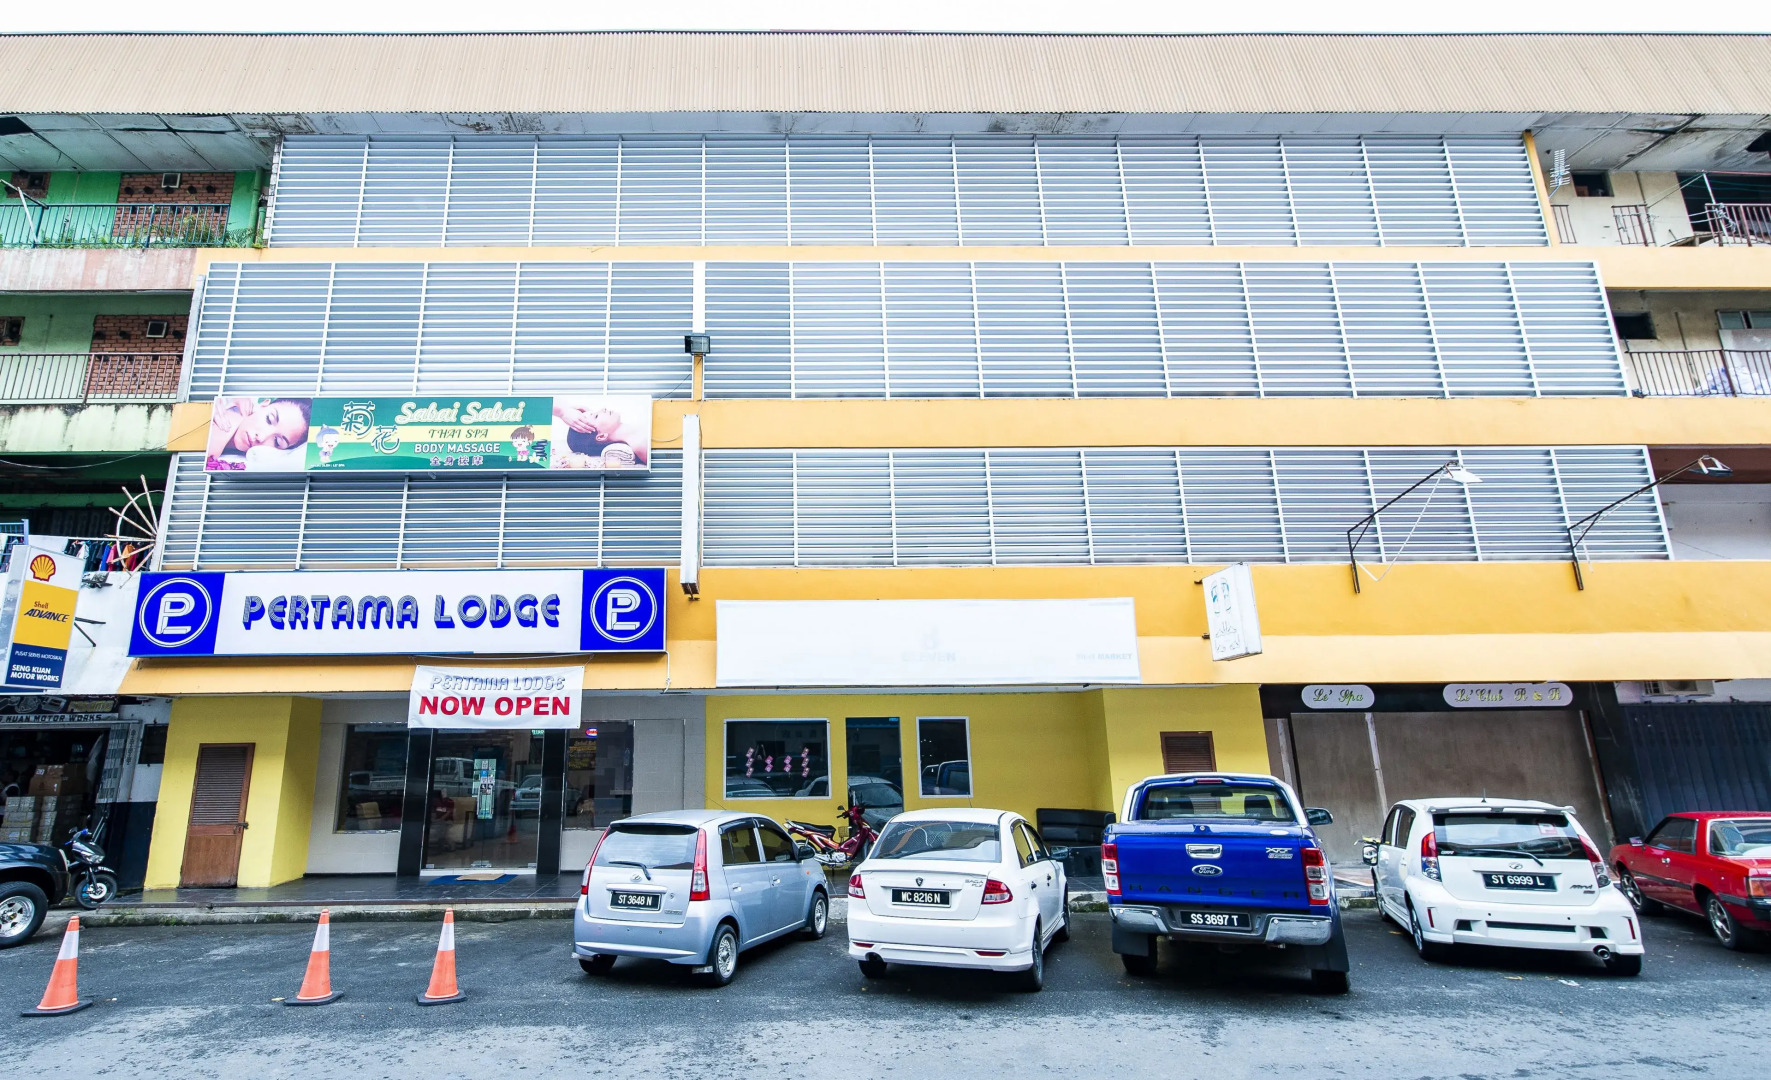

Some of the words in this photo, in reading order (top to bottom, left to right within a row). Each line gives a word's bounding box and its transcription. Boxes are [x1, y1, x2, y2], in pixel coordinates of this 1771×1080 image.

[395, 402, 460, 424] Sabai
[461, 402, 526, 424] Sabai
[428, 428, 462, 439] THAI
[465, 428, 489, 439] SPA
[414, 443, 445, 454] BODY
[447, 443, 500, 454] MASSAGE
[430, 455, 484, 467] 全身按摩
[34, 601, 49, 609] Shell
[24, 608, 70, 623] ADVANCE
[242, 594, 419, 631] PERTAMA
[434, 593, 561, 629] LODGE
[12, 664, 31, 673] SENG
[32, 666, 51, 675] KUAN
[10, 672, 36, 681] MOTOR
[36, 674, 60, 682] WORKS
[430, 675, 509, 691] PERTAMA
[513, 675, 566, 691] LODGE
[1338, 688, 1364, 706] Spa
[1475, 688, 1504, 702] Club
[1514, 688, 1528, 701] R
[1533, 690, 1543, 701] &
[1547, 687, 1562, 701] R
[419, 696, 486, 716] NOW
[494, 696, 570, 716] OPEN
[6, 715, 31, 723] KUAN
[34, 714, 65, 723] MOTOR
[69, 714, 102, 722] WORKS
[1198, 866, 1216, 876] Ford
[1491, 874, 1504, 885] ST
[1507, 875, 1534, 886] 6999
[1536, 876, 1545, 886] L
[901, 891, 912, 902] WC
[913, 892, 933, 903] 8216
[934, 893, 941, 903] N
[1129, 883, 1300, 900] RANGER
[617, 894, 628, 904] ST
[627, 895, 645, 906] 3648
[646, 897, 652, 906] N
[1190, 912, 1203, 925] SS
[1205, 913, 1229, 926] 3697
[1231, 915, 1239, 927] T
